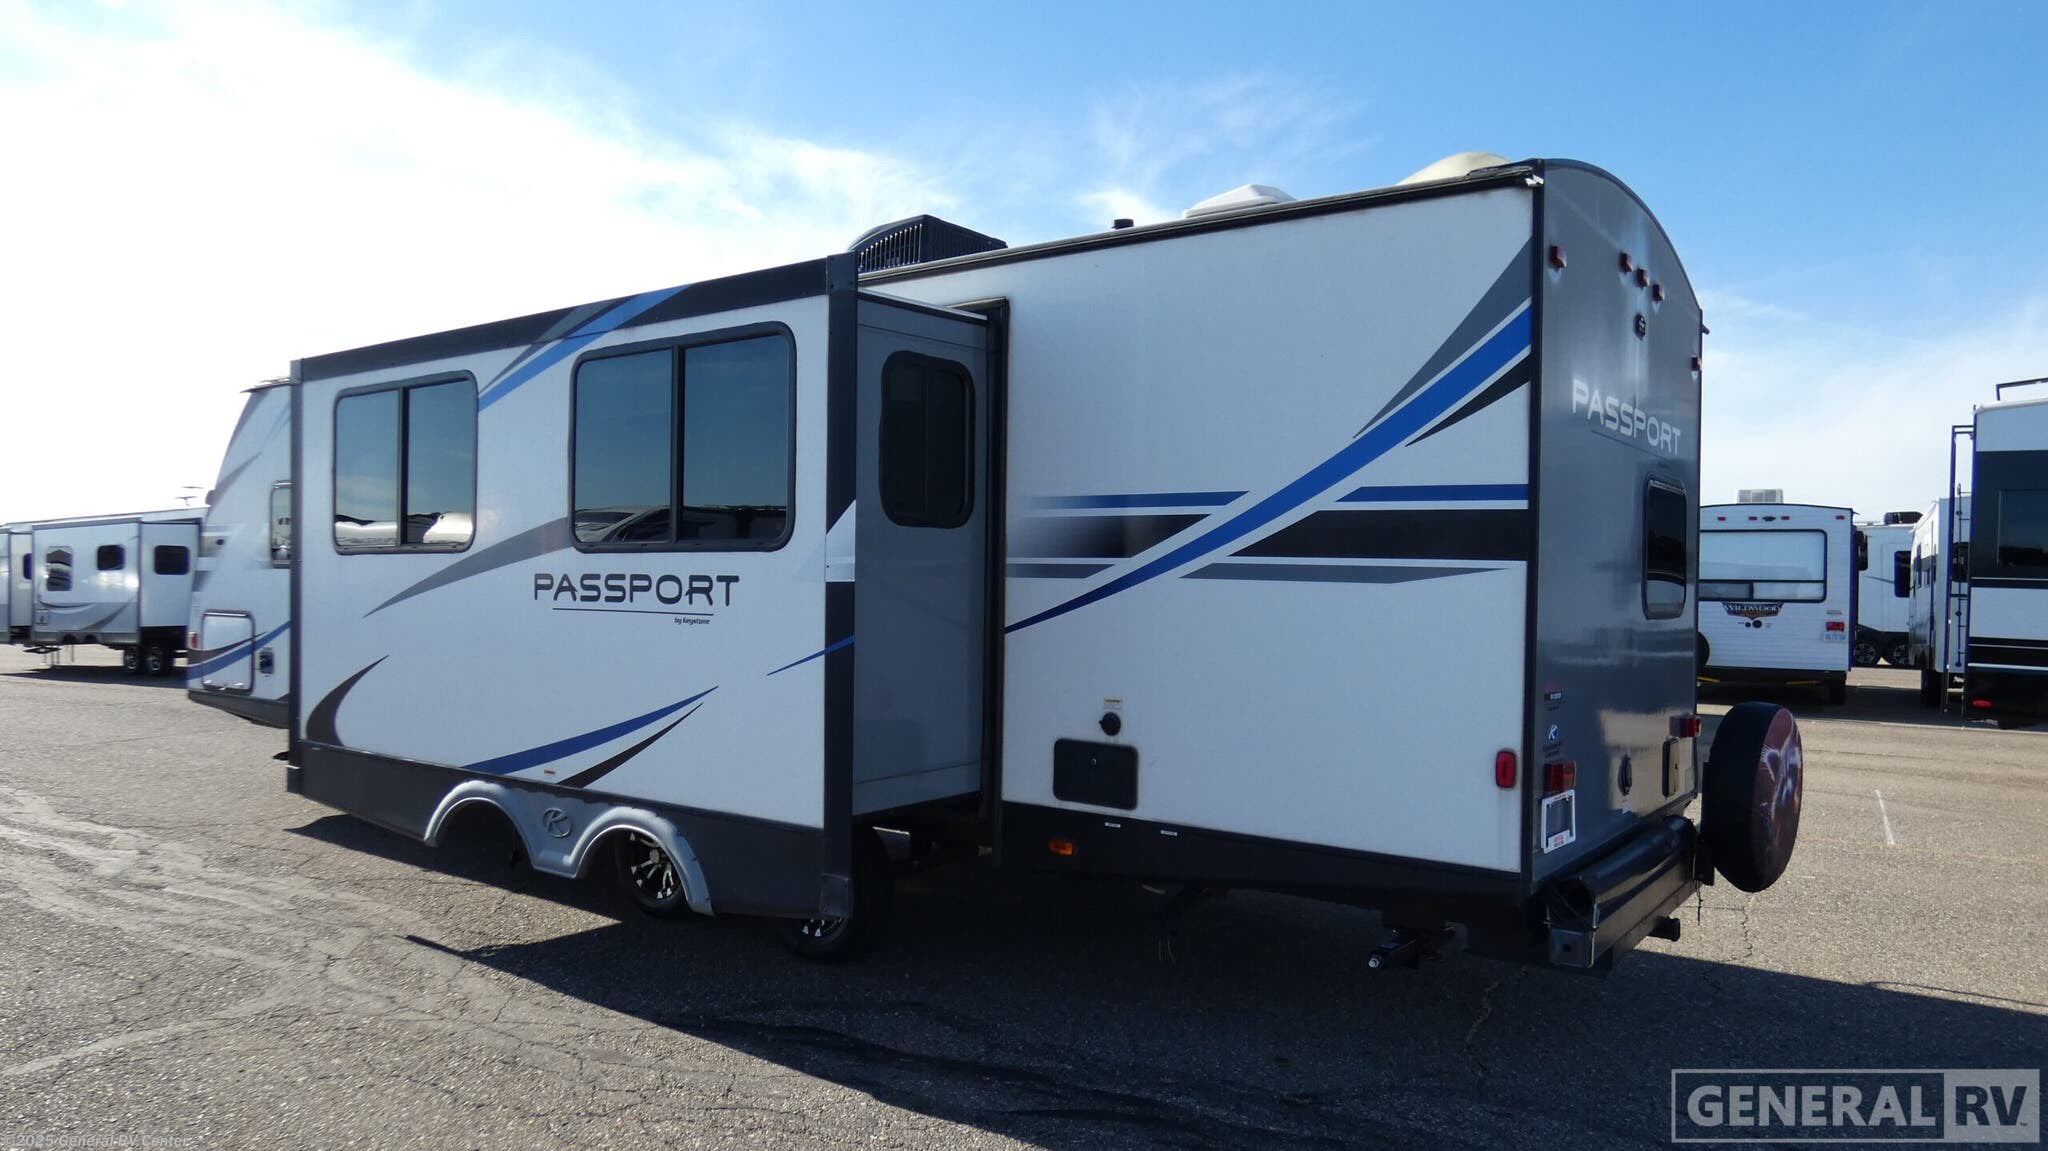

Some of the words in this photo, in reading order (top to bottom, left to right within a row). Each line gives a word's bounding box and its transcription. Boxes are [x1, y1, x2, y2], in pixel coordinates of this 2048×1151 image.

[1572, 378, 1681, 456] PASSPORT
[534, 573, 740, 607] PASSPORT
[683, 617, 710, 625] Keystone
